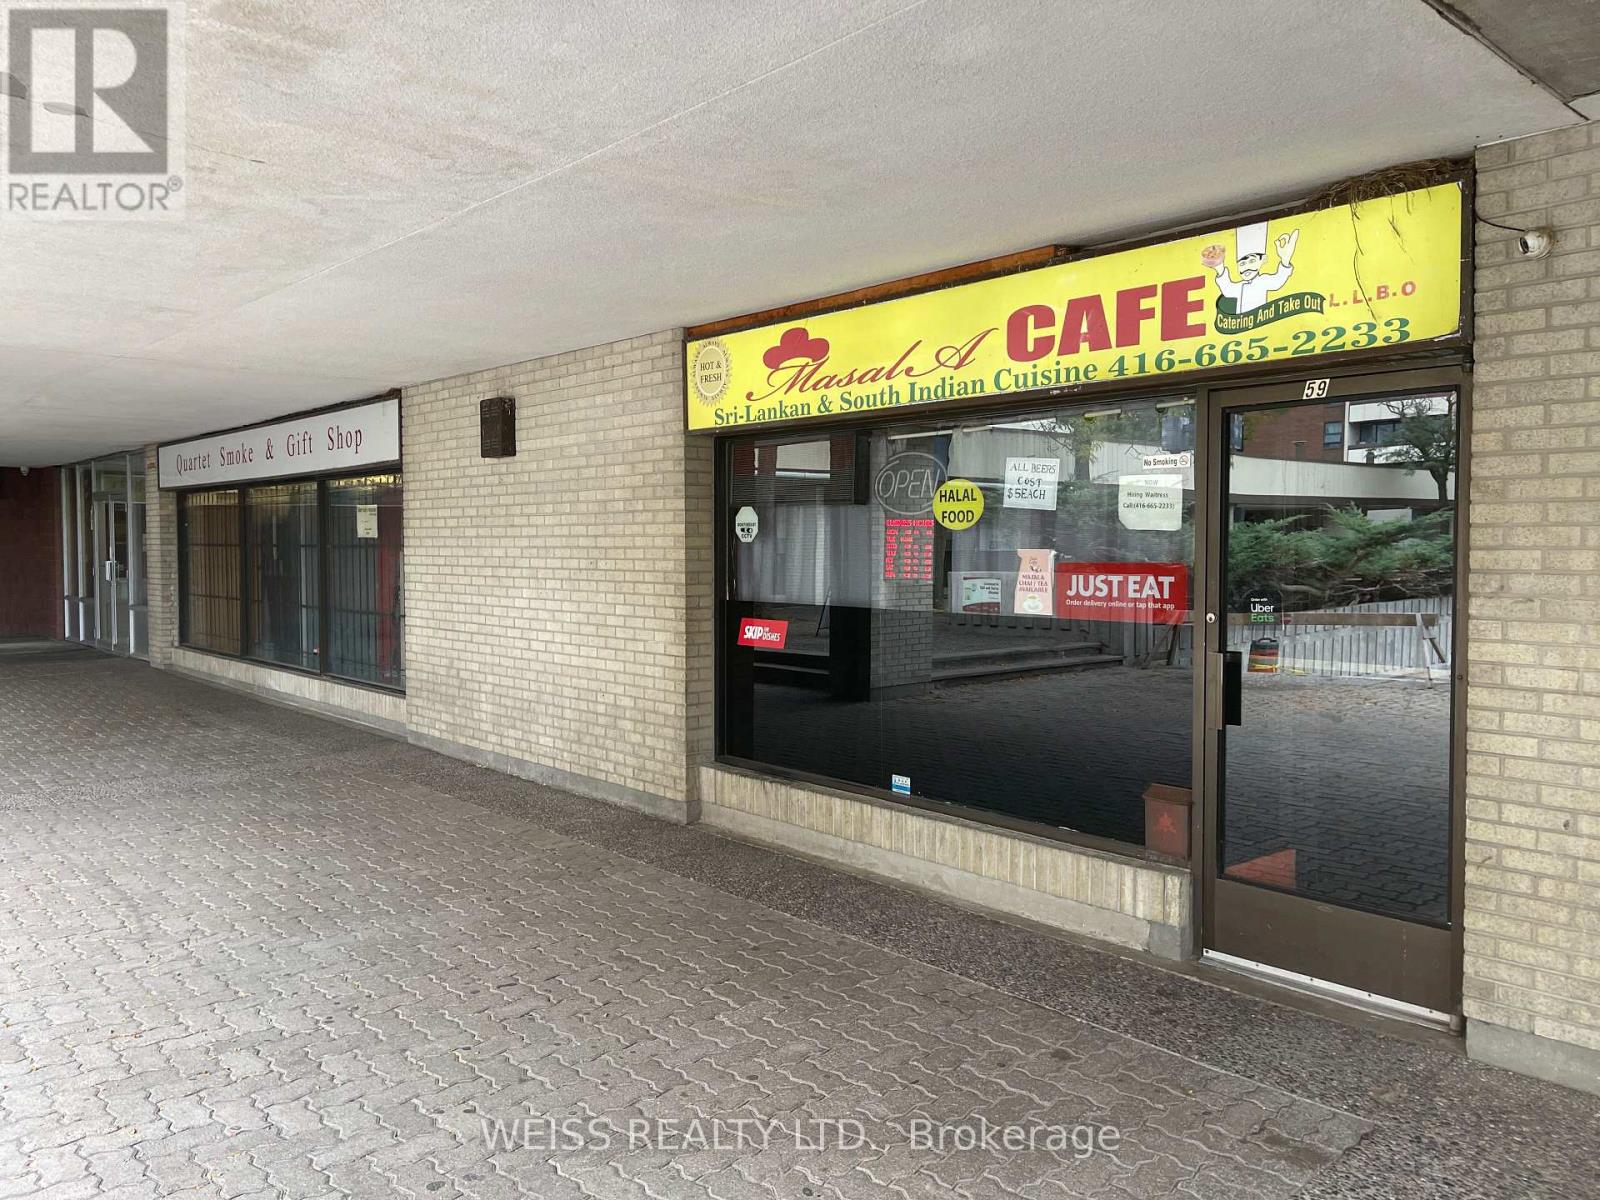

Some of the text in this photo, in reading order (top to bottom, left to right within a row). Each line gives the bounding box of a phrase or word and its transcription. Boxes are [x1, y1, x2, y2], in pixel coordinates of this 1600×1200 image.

[1216, 294, 1321, 330] Catering And Take Out
[1006, 275, 1206, 363] CAFE
[700, 361, 722, 371] HOT &
[714, 317, 1412, 426] Sri-Lankan & South Indian Cuisine 416-665-2233
[700, 373, 722, 384] FRESH
[1304, 380, 1328, 398] 59
[176, 424, 363, 476] Quartet Smoke & Gift Shop
[1010, 463, 1057, 474] ALL BEERS
[1143, 457, 1178, 467] No Smoking
[879, 468, 941, 499] OPEN
[1017, 476, 1042, 488] COST
[939, 488, 977, 503] HALAL
[1126, 491, 1143, 499] Hiring
[941, 510, 975, 523] FOOD
[1065, 575, 1175, 599] JUST EAT
[1083, 599, 1107, 608] delivery
[1136, 601, 1146, 609] tap
[1250, 603, 1275, 613] Uber
[1250, 613, 1275, 622] Eats
[743, 625, 763, 639] SKIP
[762, 631, 781, 641] DISHES
